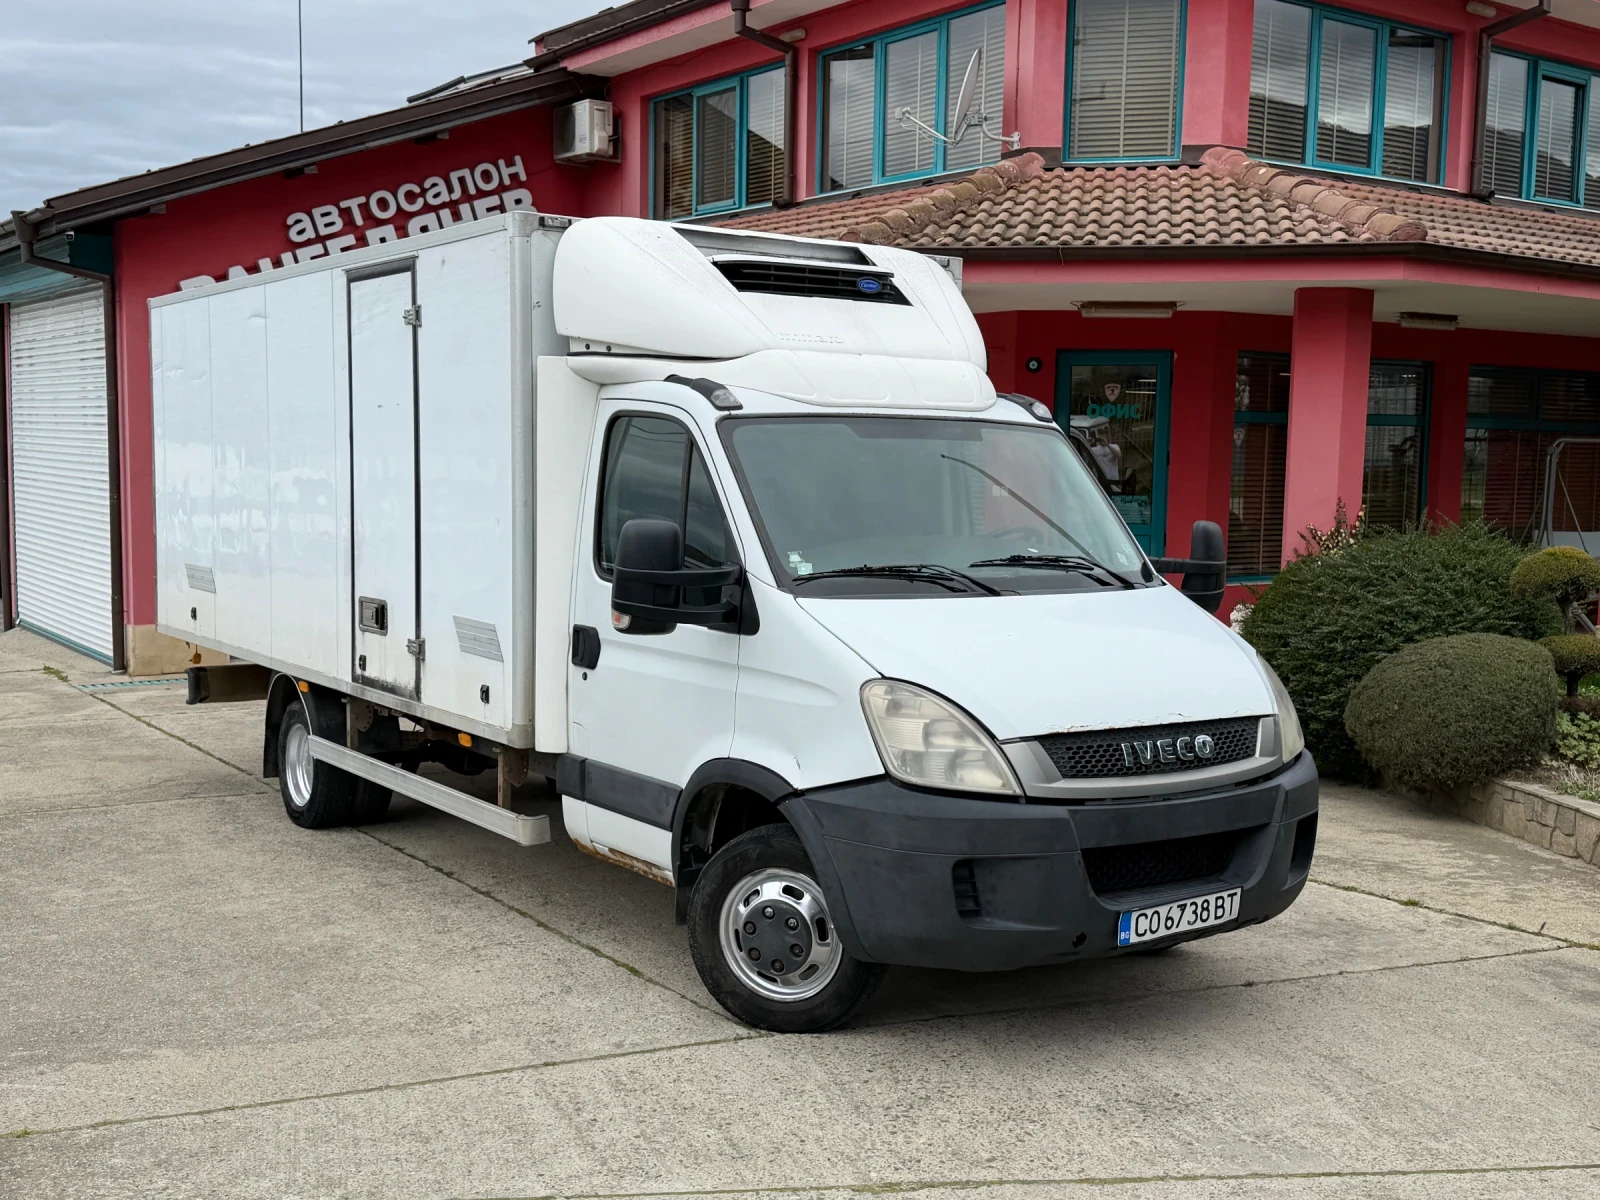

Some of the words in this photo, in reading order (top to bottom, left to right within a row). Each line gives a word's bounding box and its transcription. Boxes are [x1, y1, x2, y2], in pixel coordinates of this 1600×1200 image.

[286, 155, 527, 243] автосалон
[1086, 402, 1140, 420] ОФИС
[1121, 734, 1214, 767] IVECO
[1120, 931, 1130, 940] BG
